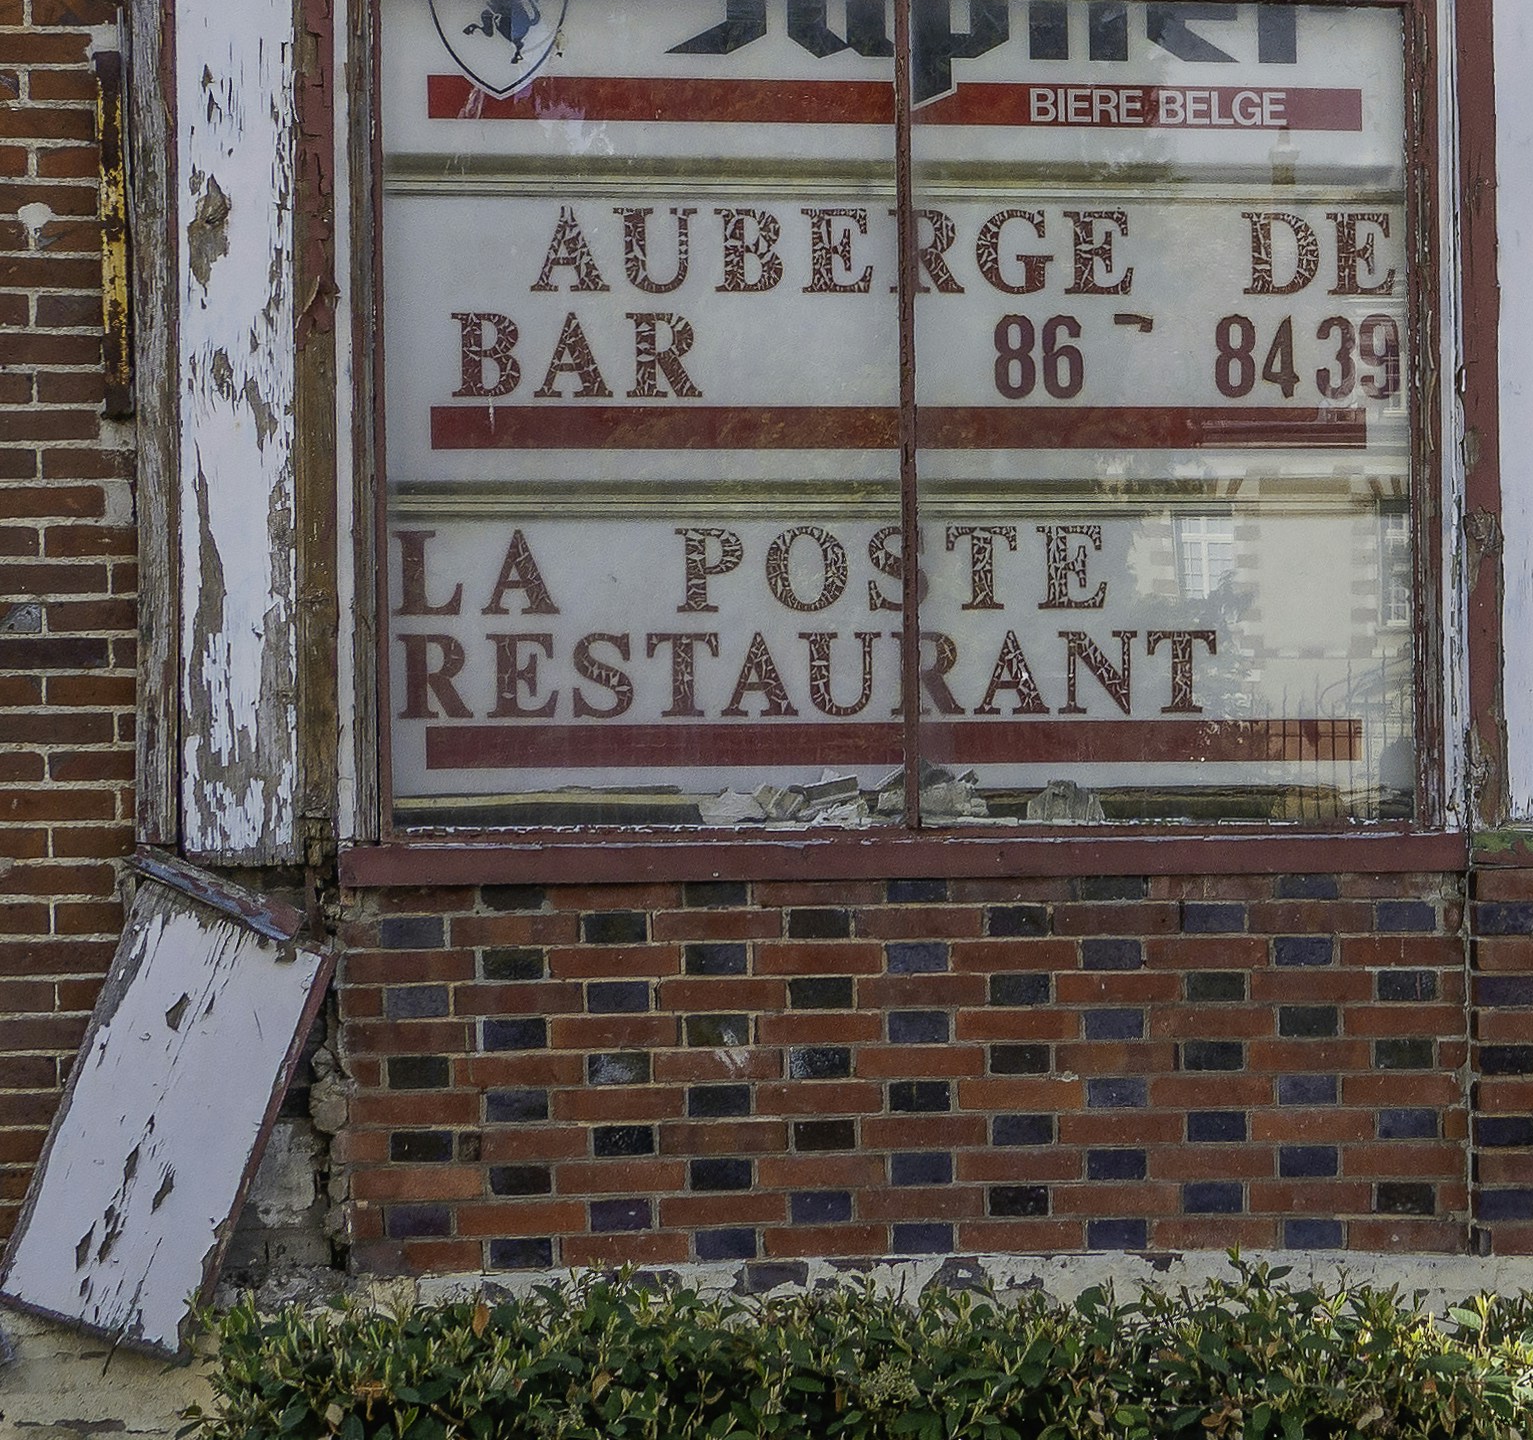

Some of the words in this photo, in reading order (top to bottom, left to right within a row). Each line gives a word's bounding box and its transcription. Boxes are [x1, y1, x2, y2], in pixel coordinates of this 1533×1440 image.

[1028, 86, 1142, 124] BIERE
[1157, 88, 1287, 128] BELGE
[530, 205, 1135, 297] AUBERGE
[1241, 210, 1397, 298] DE
[450, 311, 704, 400] BAR
[993, 313, 1084, 401] 86
[390, 528, 561, 616] LA
[674, 524, 1109, 614] POSTE
[396, 629, 1217, 720] RESTAURANT
